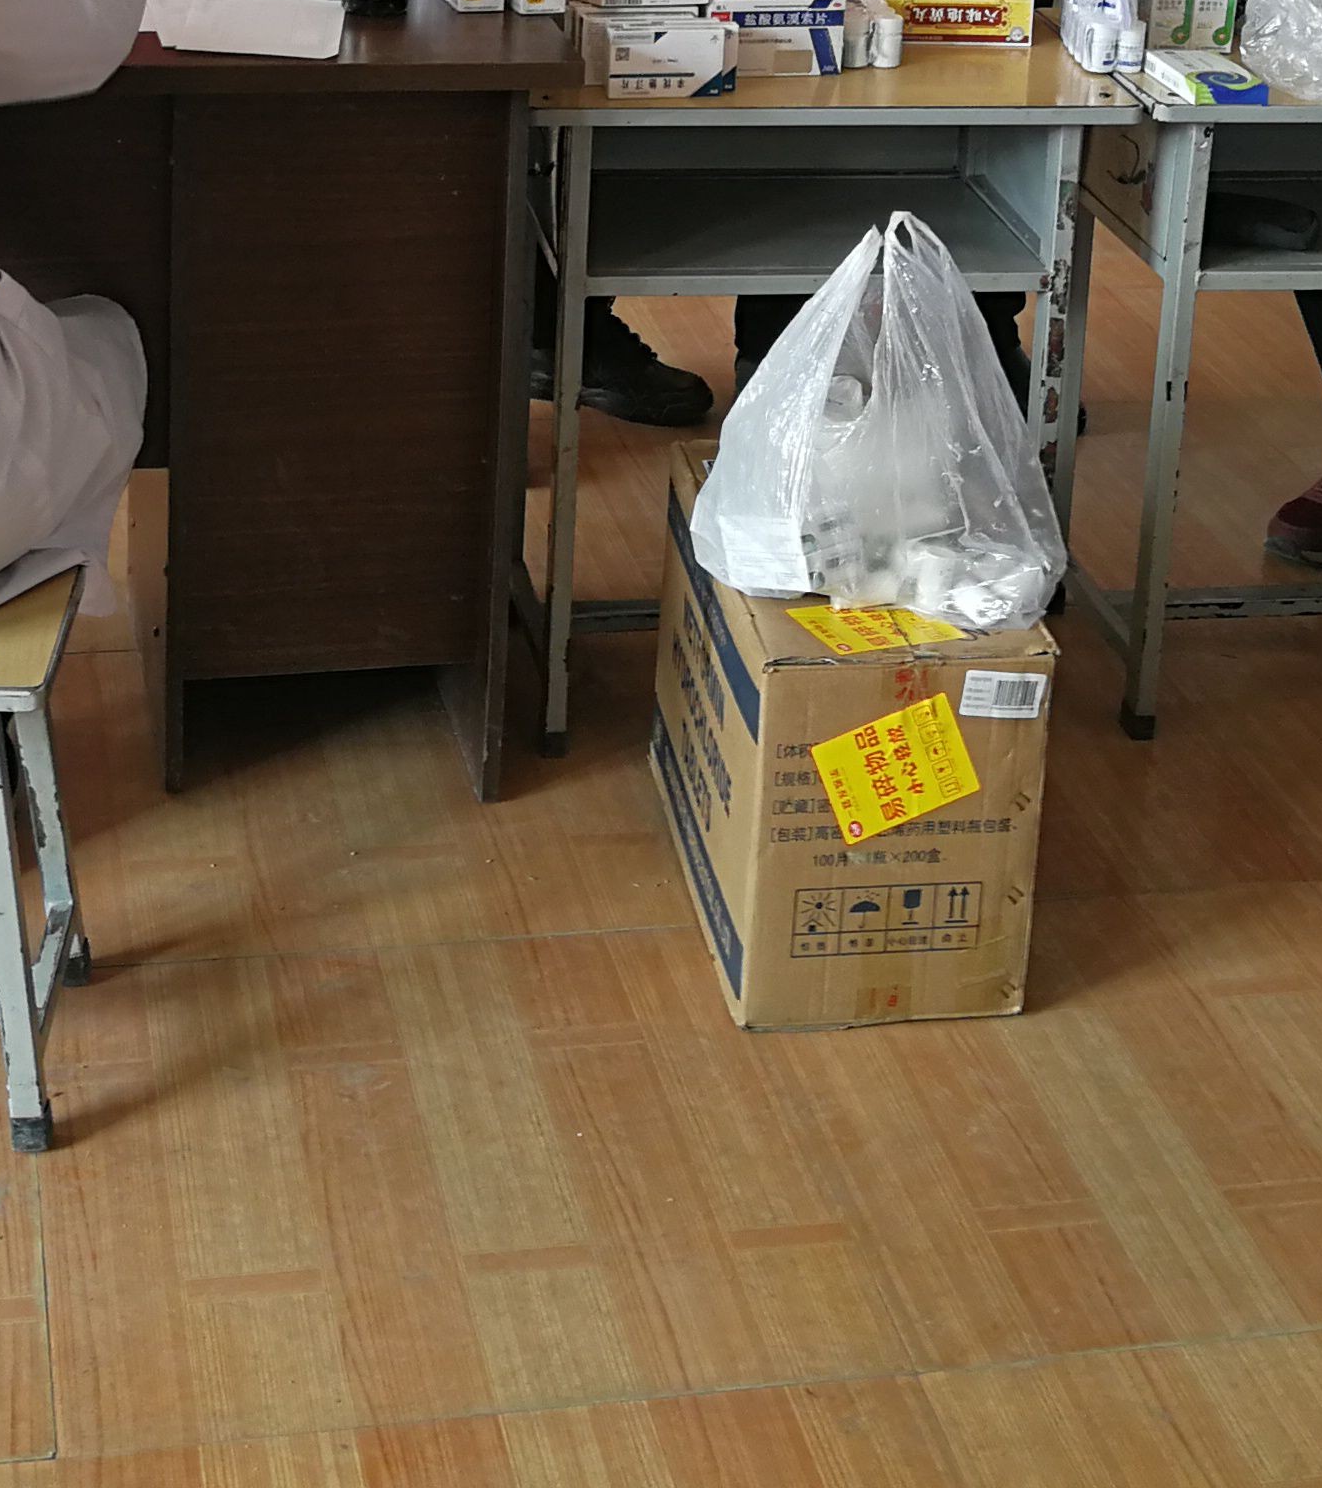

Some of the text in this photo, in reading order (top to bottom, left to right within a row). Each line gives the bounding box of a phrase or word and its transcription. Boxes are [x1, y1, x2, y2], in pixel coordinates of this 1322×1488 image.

[912, 6, 999, 24] 六味地黄丸
[852, 724, 908, 822] 易碎物品
[886, 724, 925, 795] 小心轻放
